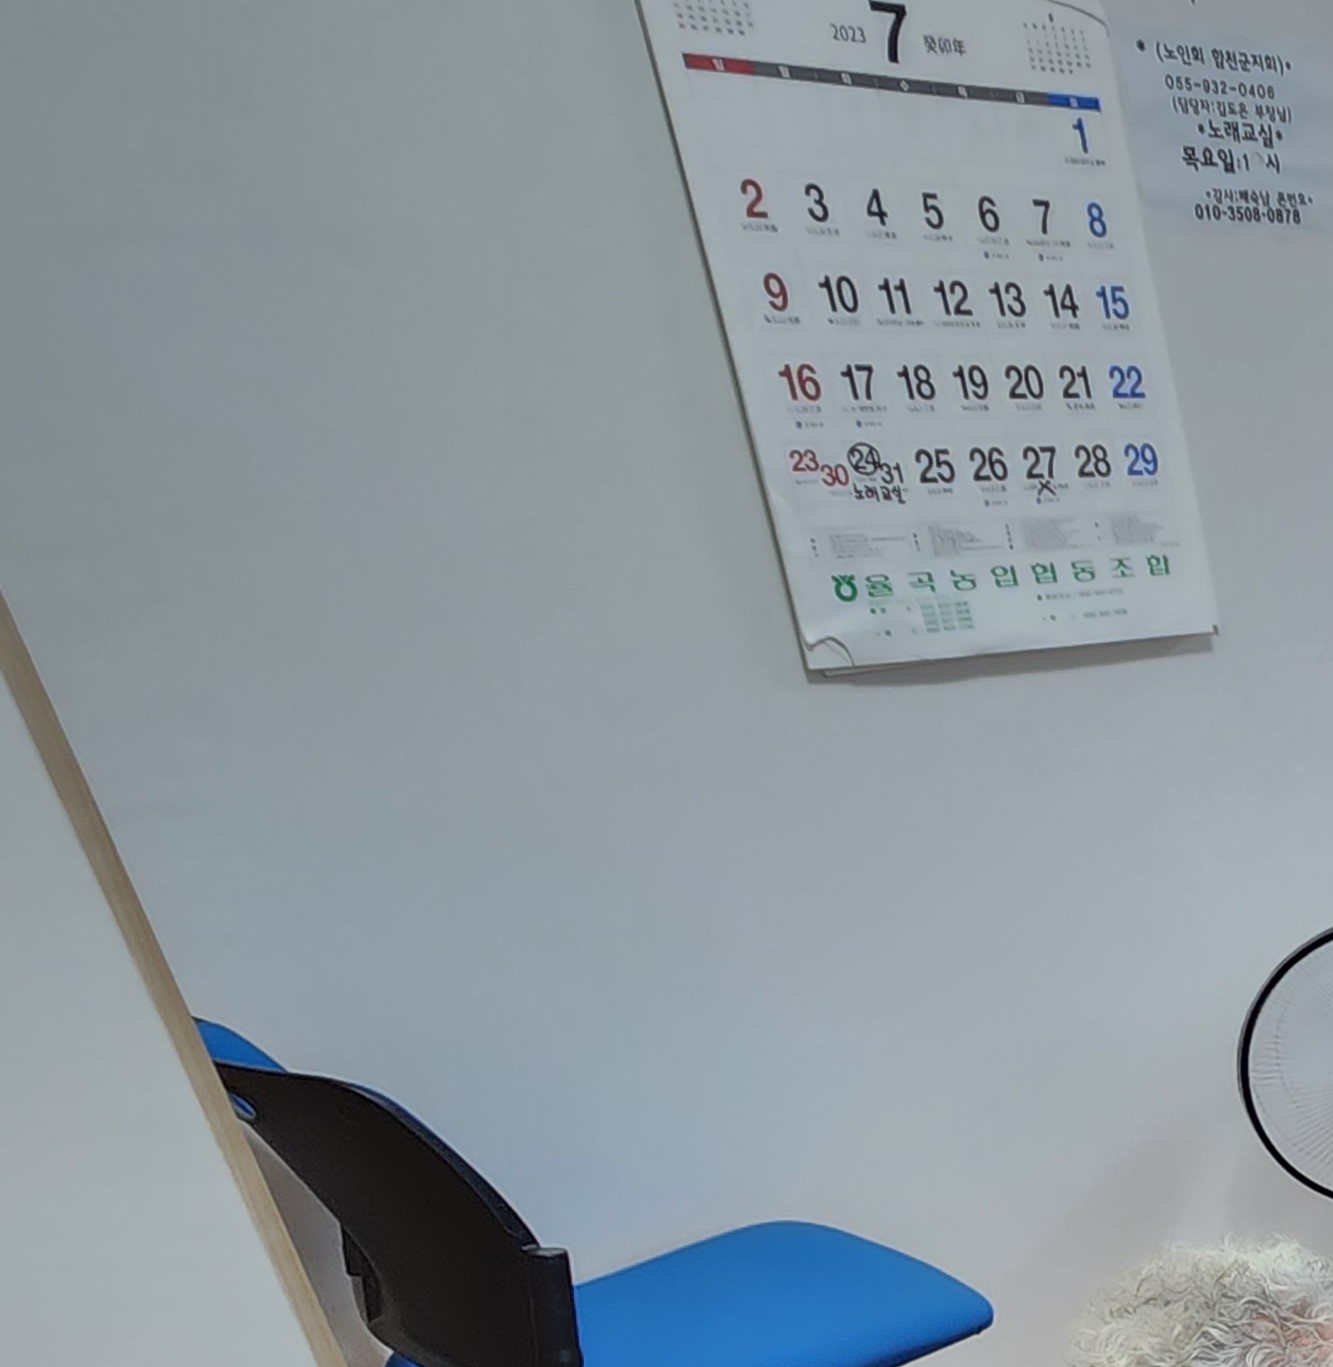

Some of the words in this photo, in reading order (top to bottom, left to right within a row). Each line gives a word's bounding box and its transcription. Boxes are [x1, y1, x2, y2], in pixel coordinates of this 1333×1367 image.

[830, 23, 867, 44] 2023
[869, 0, 908, 63] 7
[1072, 117, 1089, 153] 1
[740, 179, 769, 221] 2
[804, 183, 830, 223] 3
[867, 188, 889, 226] 4
[921, 192, 944, 230] 5
[978, 195, 1000, 232] 6
[1032, 199, 1051, 235] 7
[1087, 203, 1108, 238] 8
[764, 272, 789, 312] 9
[818, 275, 859, 313] 10
[878, 277, 912, 314] 11
[934, 280, 973, 316] 12
[989, 281, 1026, 318] 13
[1044, 283, 1079, 318] 14
[1096, 285, 1130, 320] 15
[778, 363, 822, 401] 16
[840, 363, 874, 401] 17
[897, 364, 936, 400] 18
[953, 364, 989, 400] 19
[1005, 364, 1044, 400] 20
[1059, 364, 1093, 399] 21
[1109, 364, 1146, 399] 22
[789, 449, 819, 473] 23
[820, 463, 849, 487] 30
[849, 447, 881, 472] 24
[880, 462, 906, 485] 31
[915, 448, 956, 484] 25
[969, 446, 1008, 483] 26
[1022, 445, 1057, 480] 27
[1074, 444, 1112, 479] 28
[1124, 442, 1159, 477] 29
